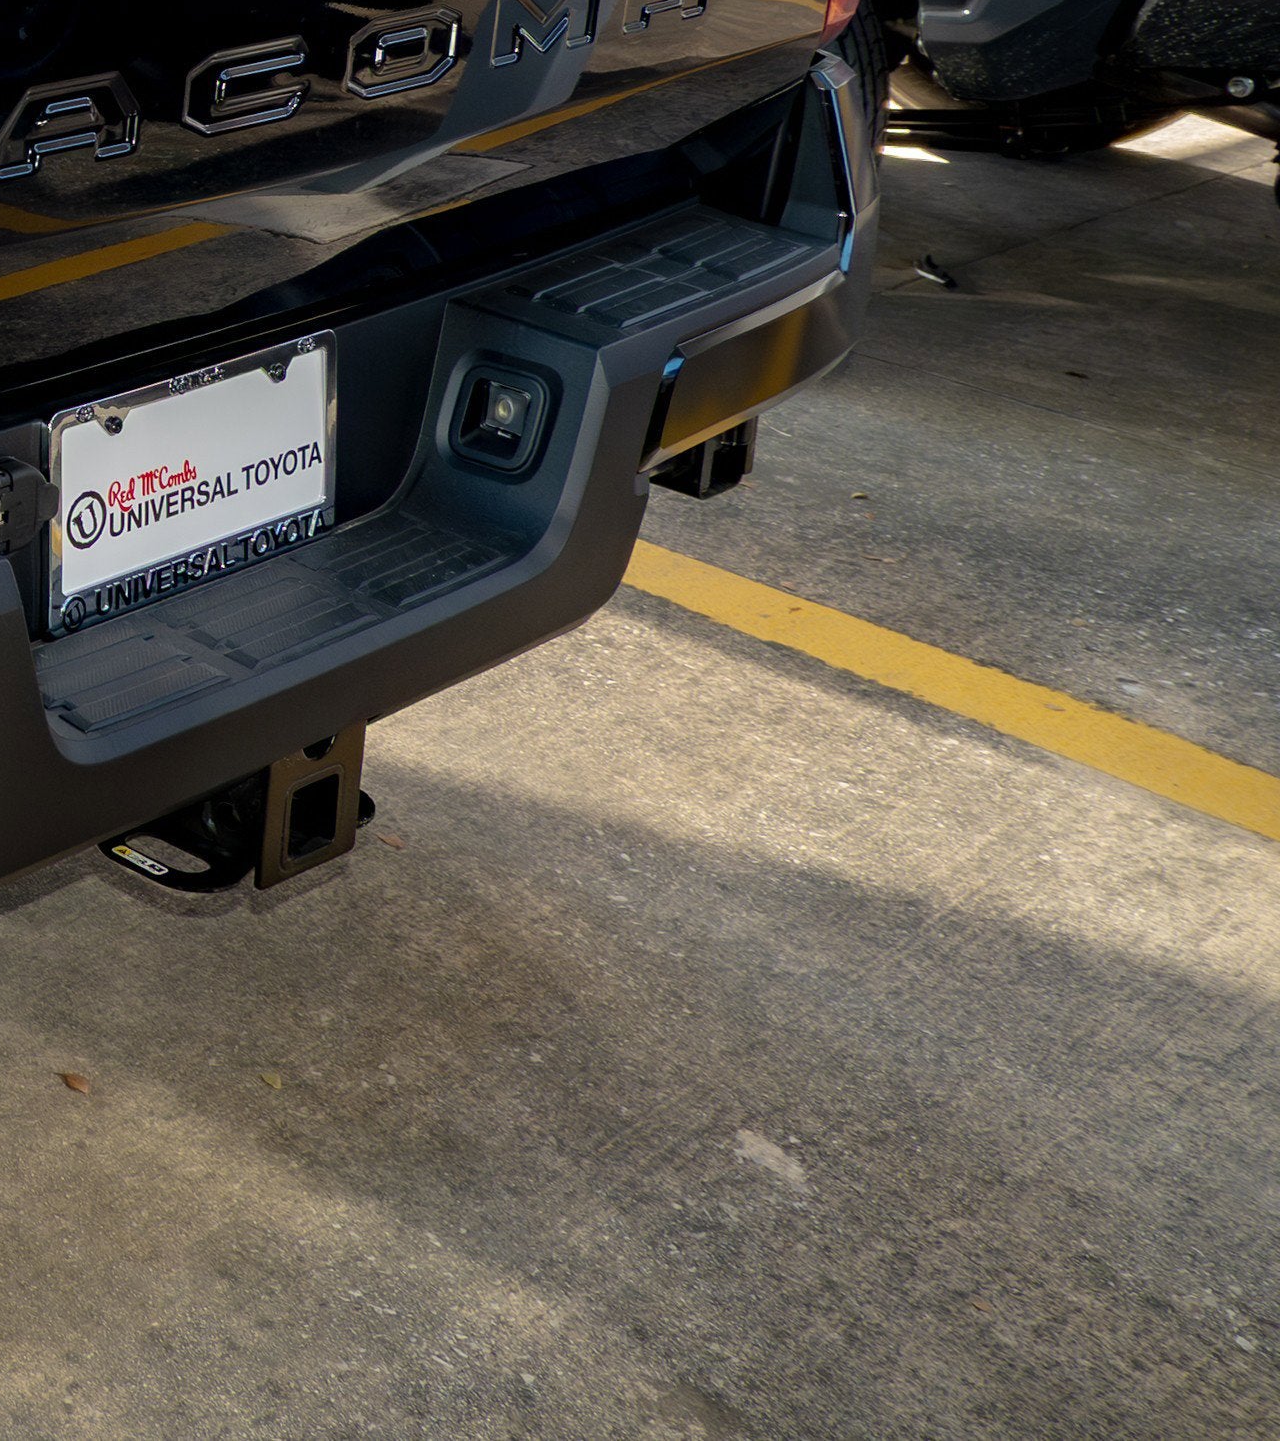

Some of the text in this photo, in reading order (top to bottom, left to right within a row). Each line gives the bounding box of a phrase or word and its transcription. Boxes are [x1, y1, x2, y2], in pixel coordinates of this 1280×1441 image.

[107, 459, 198, 513] Red McCombs
[109, 472, 238, 537] UNIVERSAL
[241, 441, 323, 490] TOYOTA
[94, 542, 237, 616] UNIVERSAL
[238, 509, 327, 563] TOYOTA
